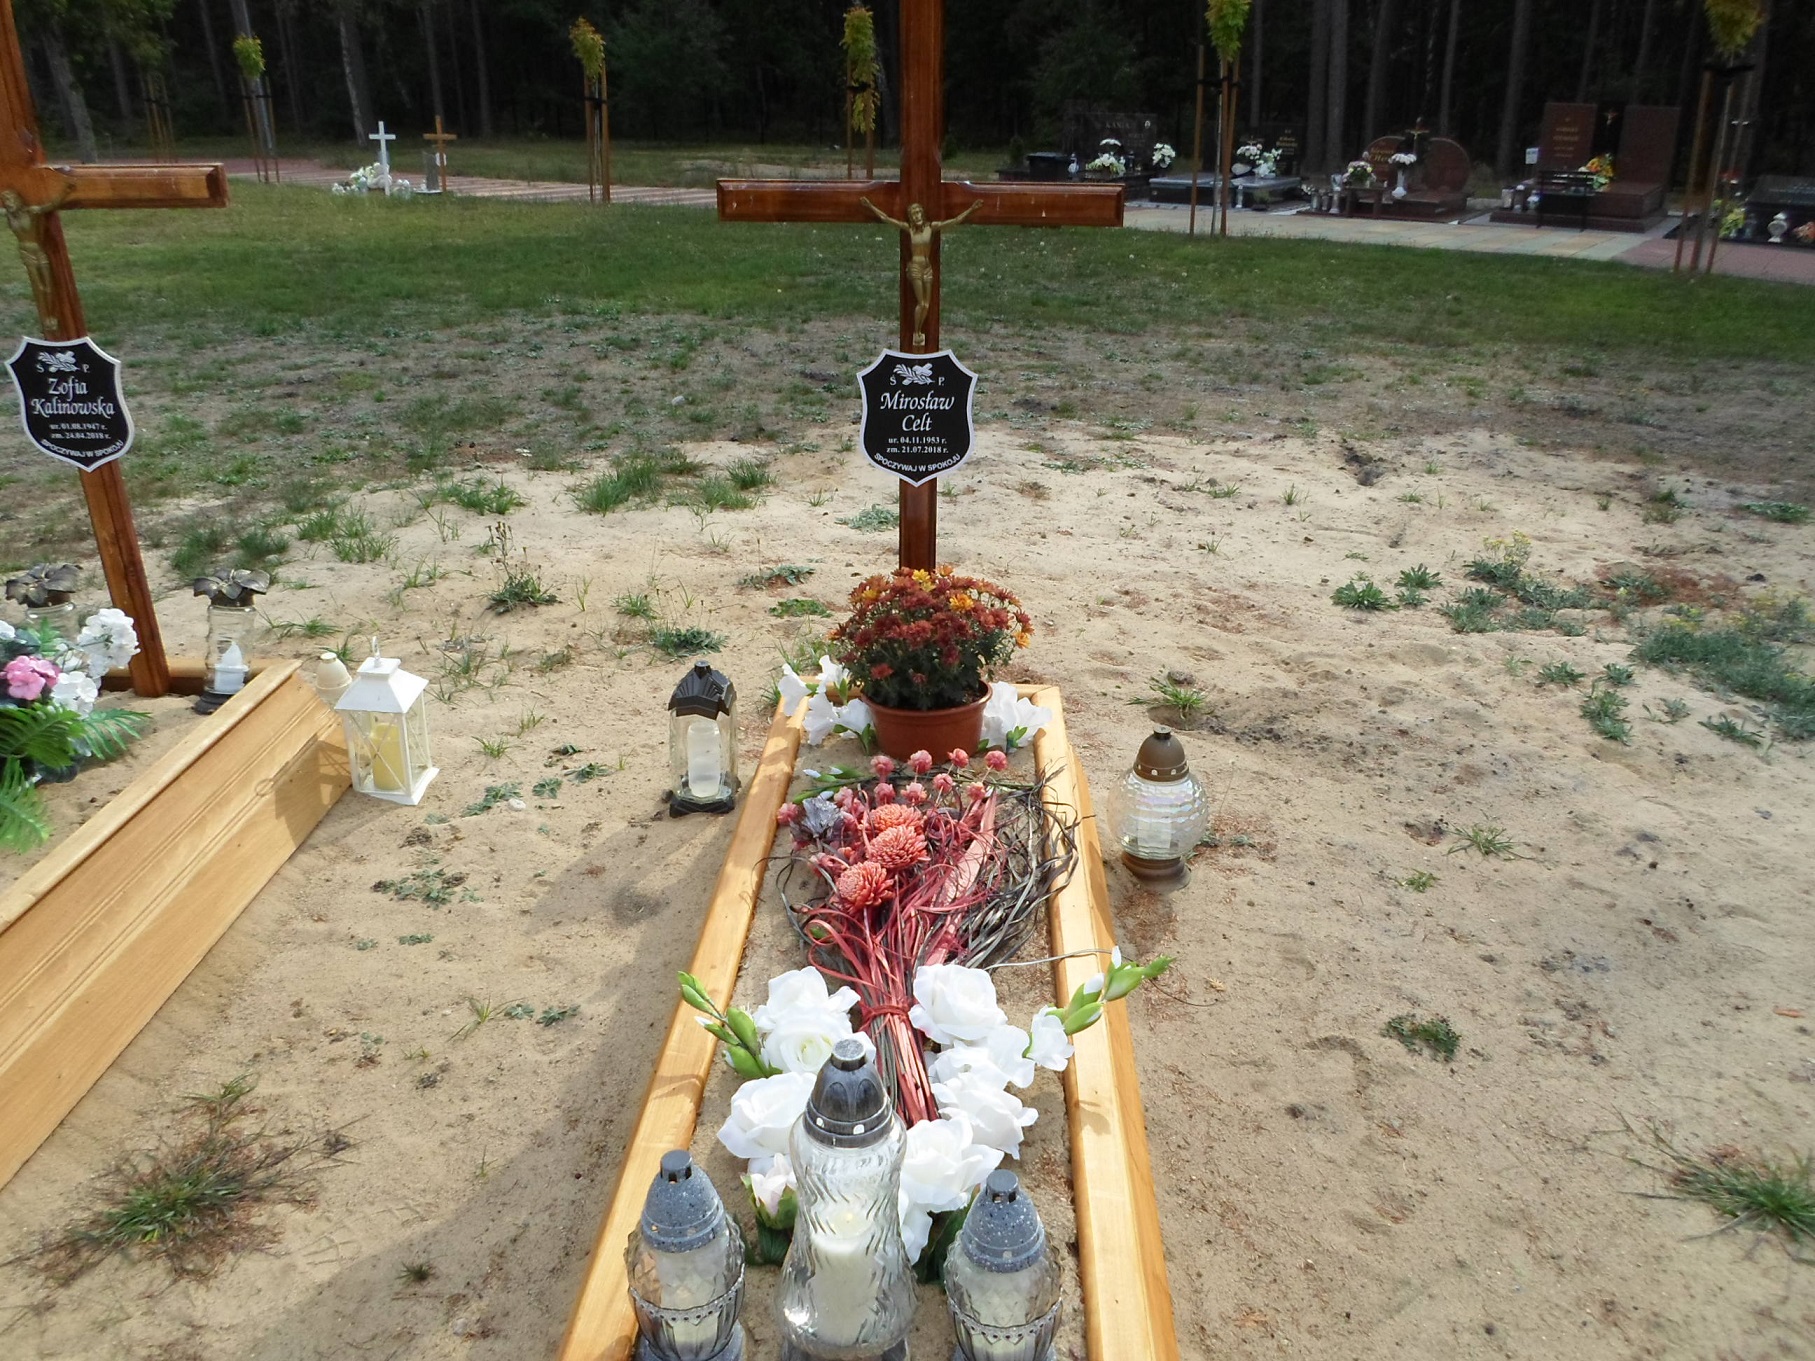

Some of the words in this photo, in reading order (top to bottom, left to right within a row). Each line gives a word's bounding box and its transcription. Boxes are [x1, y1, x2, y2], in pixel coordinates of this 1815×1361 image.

[48, 376, 88, 401] Zofia
[31, 396, 115, 419] Kalinowska
[880, 390, 955, 410] Mirosław
[902, 412, 932, 432] Celt
[86, 450, 94, 458] W
[874, 453, 917, 472] SPOCZYWAJ
[927, 454, 961, 472] SPOKOJU
